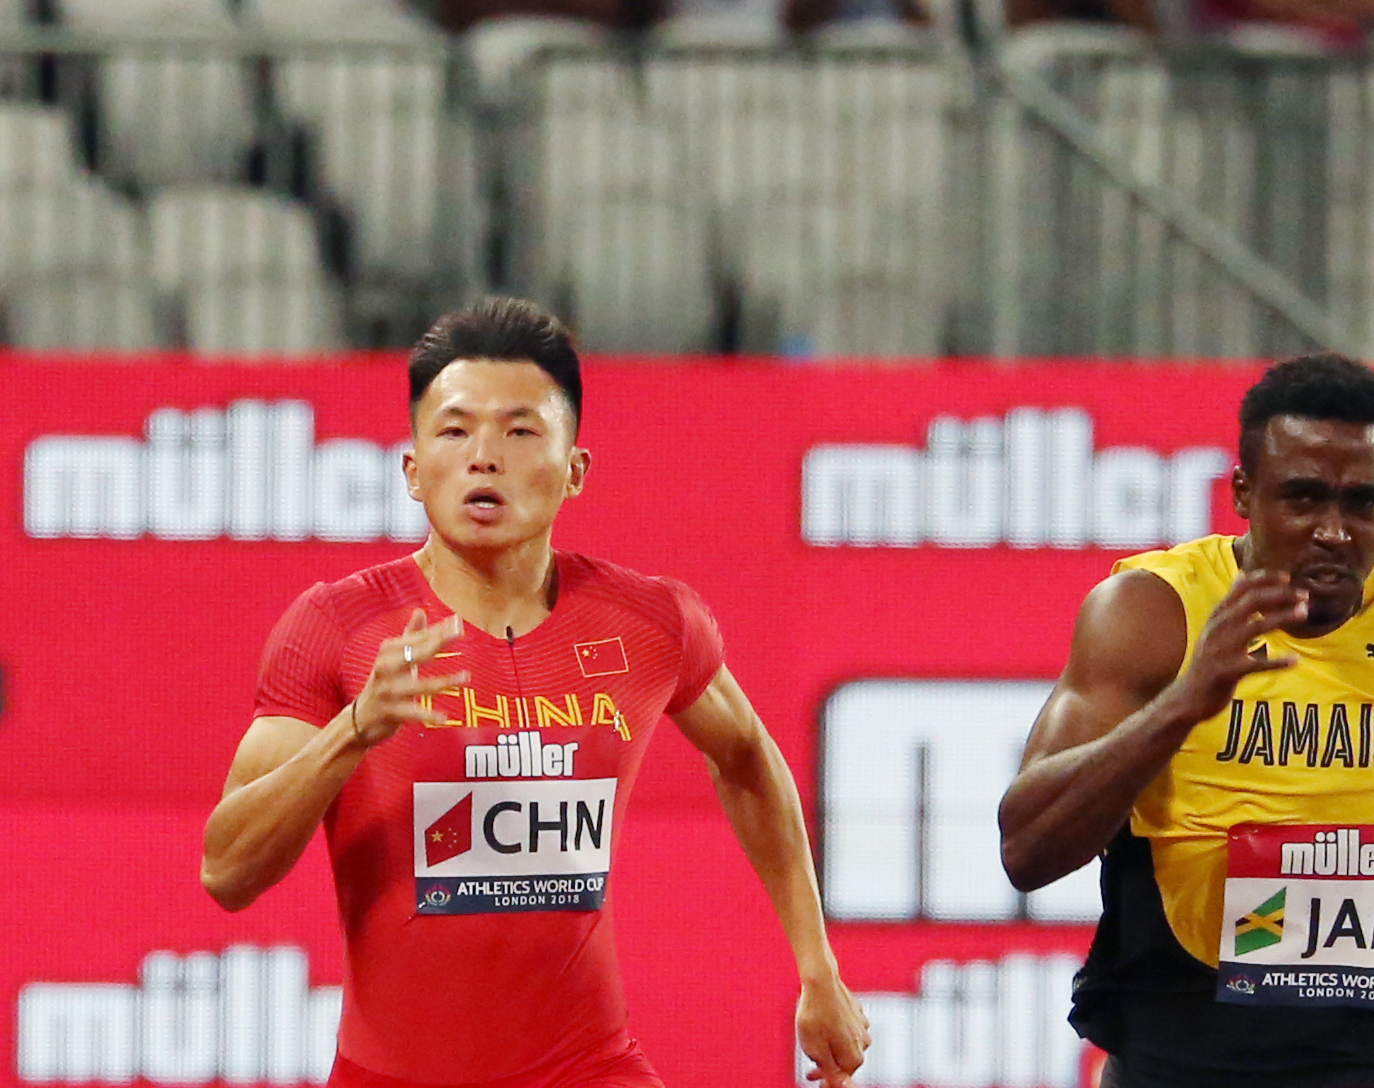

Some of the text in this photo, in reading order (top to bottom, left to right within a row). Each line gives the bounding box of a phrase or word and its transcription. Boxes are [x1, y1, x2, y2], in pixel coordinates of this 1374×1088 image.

[801, 407, 1231, 549] müller
[465, 730, 580, 779] müller
[482, 799, 606, 855] CHN
[456, 877, 605, 896] ATHLETICS WORLD CUP
[494, 894, 580, 907] LONDON 2018
[1261, 972, 1338, 988] ATHLETICS
[1299, 987, 1355, 998] LONDON
